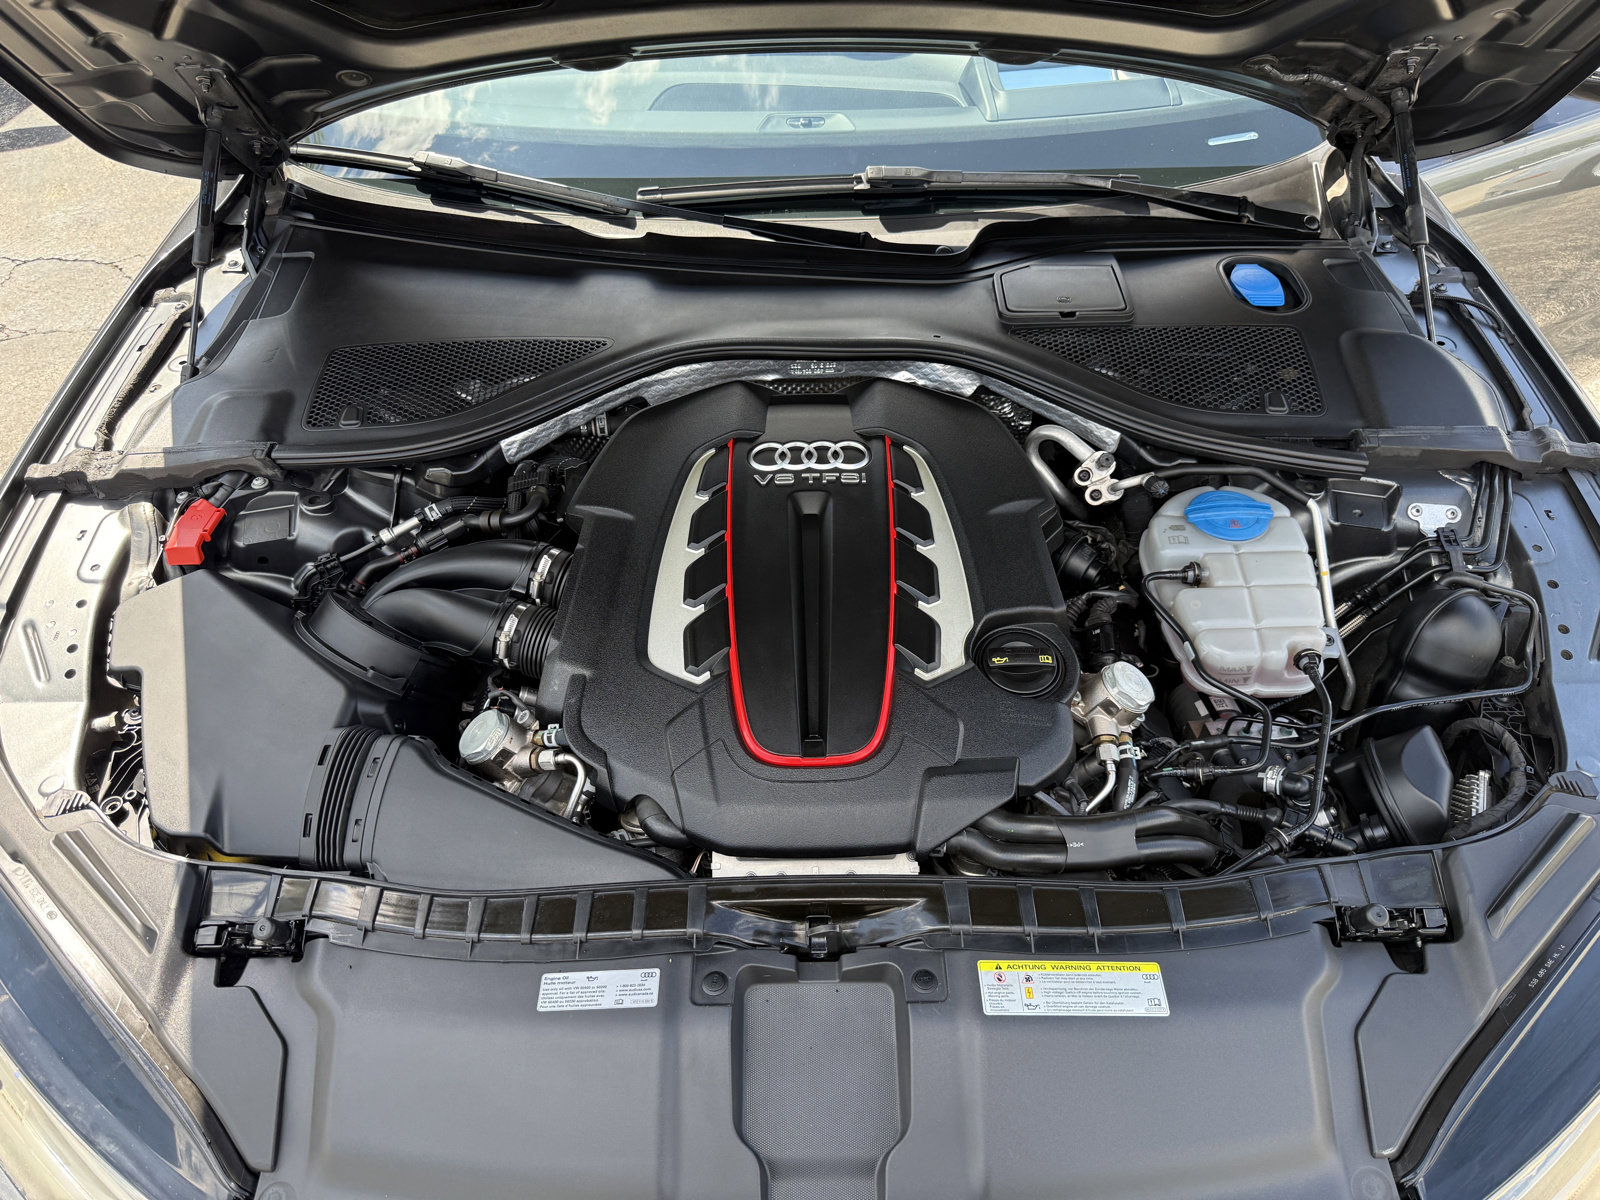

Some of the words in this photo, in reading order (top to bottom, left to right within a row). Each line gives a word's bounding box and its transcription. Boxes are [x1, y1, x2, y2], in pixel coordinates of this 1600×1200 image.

[753, 473, 795, 485] V8
[801, 472, 867, 484] TFSI
[1006, 963, 1047, 971] ACHTUNG
[1050, 964, 1092, 972] WARNING
[1096, 964, 1142, 972] ATTENTION
